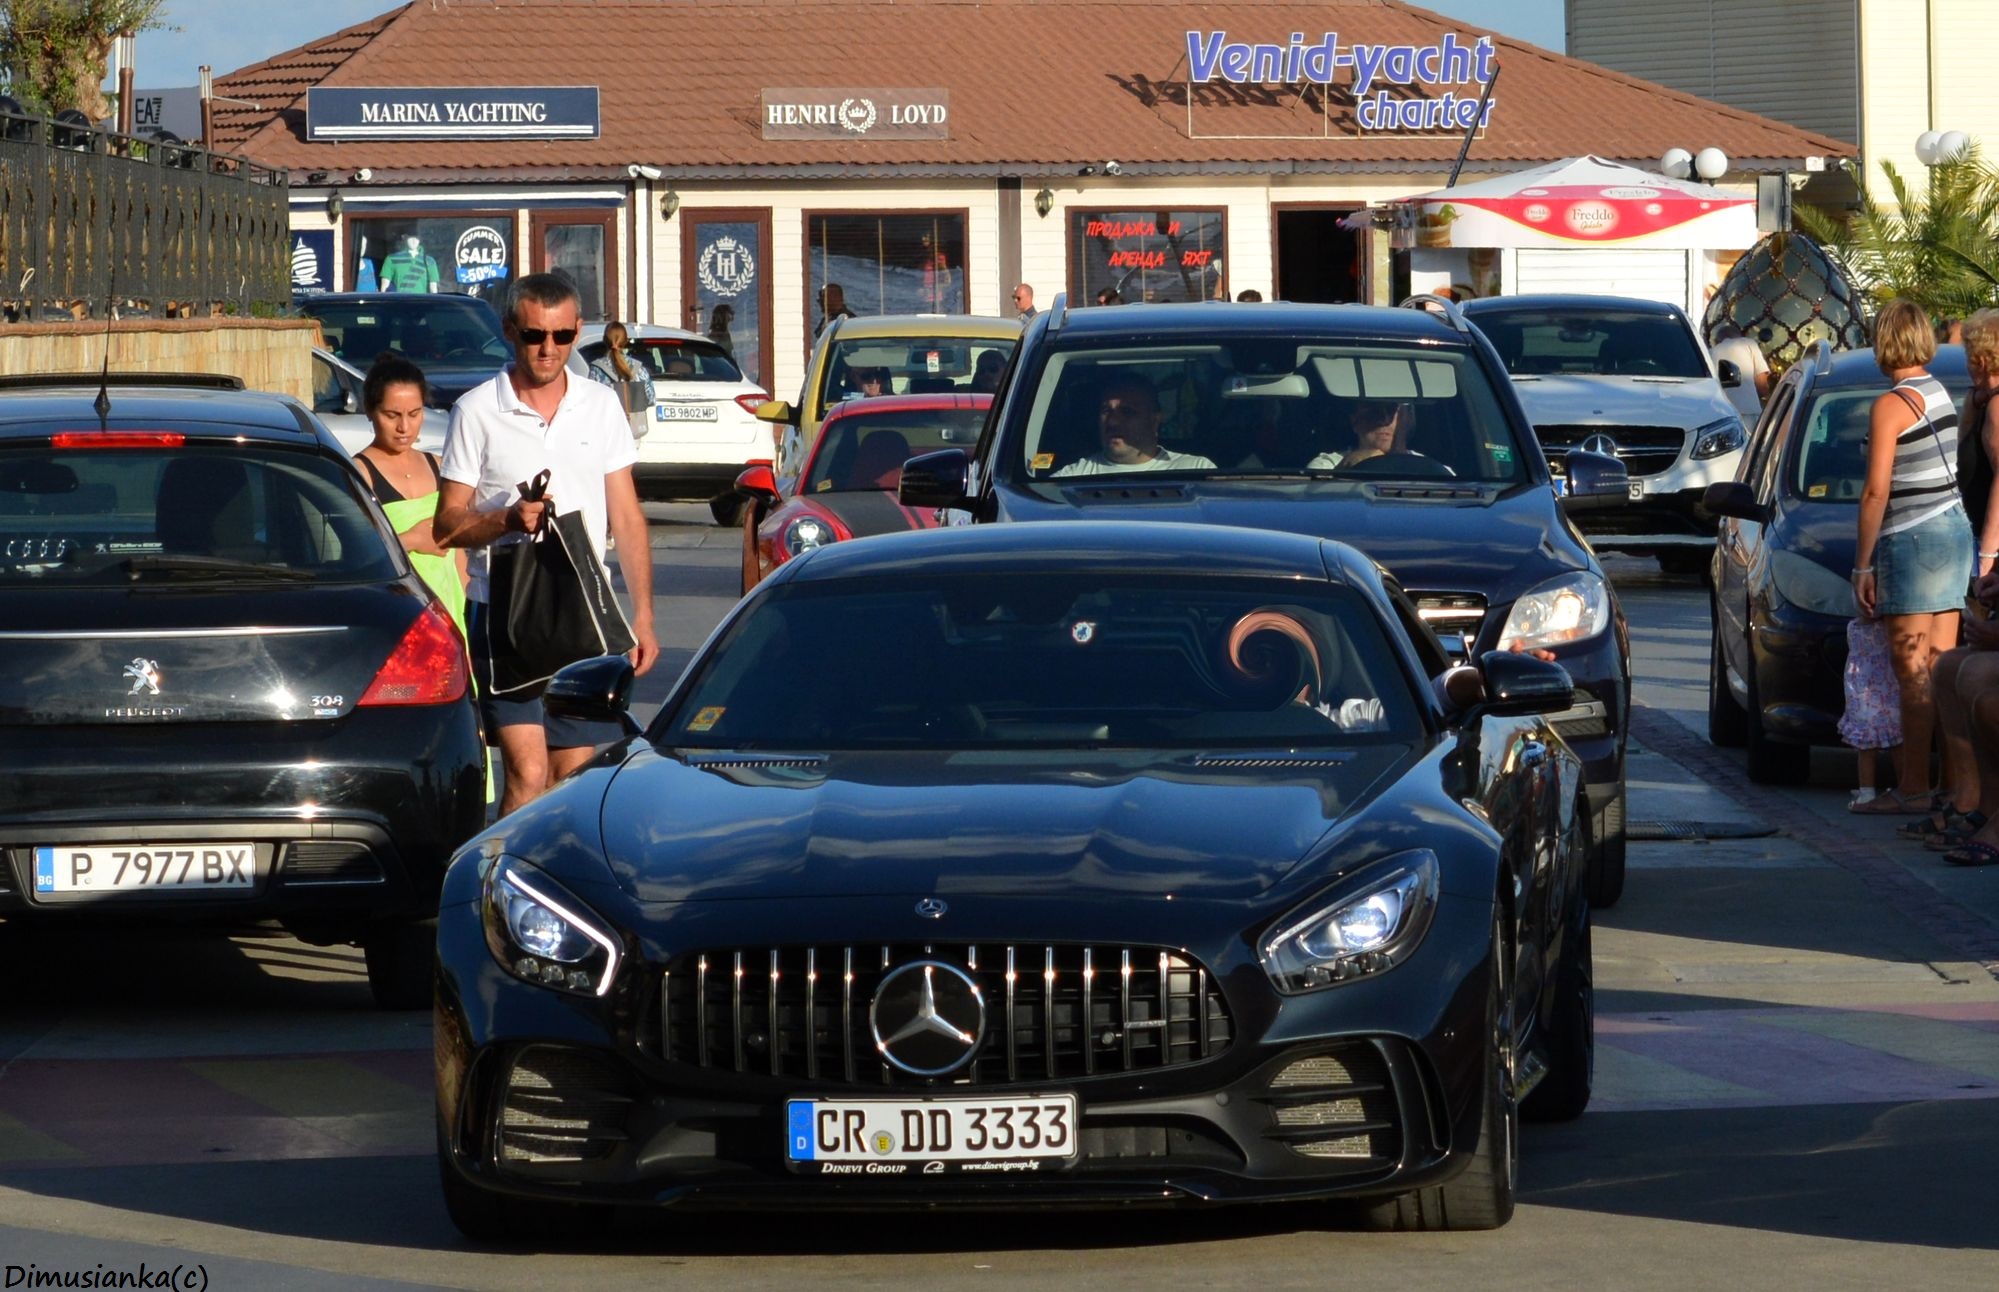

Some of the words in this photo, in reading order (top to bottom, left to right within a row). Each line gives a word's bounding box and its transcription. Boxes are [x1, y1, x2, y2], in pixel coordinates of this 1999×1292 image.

[1186, 31, 1495, 95] Venid-yacht
[361, 103, 441, 122] MARINA
[444, 103, 547, 122] YACHTING
[767, 104, 837, 124] HENRI
[891, 104, 946, 124] LOYD
[1357, 91, 1495, 129] charter
[1572, 208, 1615, 220] Freddo
[462, 230, 500, 247] SUMMER
[1086, 221, 1156, 240] ПРОДАЖА
[1168, 221, 1182, 234] И
[460, 247, 503, 264] SALE
[1108, 250, 1166, 269] АРЕНДА
[1181, 250, 1213, 265] ЯХТ
[663, 407, 676, 418] CB
[678, 407, 702, 418] 9802
[309, 695, 343, 707] 308
[105, 707, 184, 717] PEUGEOT
[38, 875, 53, 885] BG
[71, 853, 92, 886] P
[112, 851, 194, 885] 7977
[203, 850, 247, 883] BX
[796, 1136, 807, 1150] D
[817, 1109, 867, 1152] CR
[900, 1109, 952, 1152] DD
[965, 1105, 1067, 1151] 3333
[961, 1160, 1039, 1171] www.dinevigroup.bg
